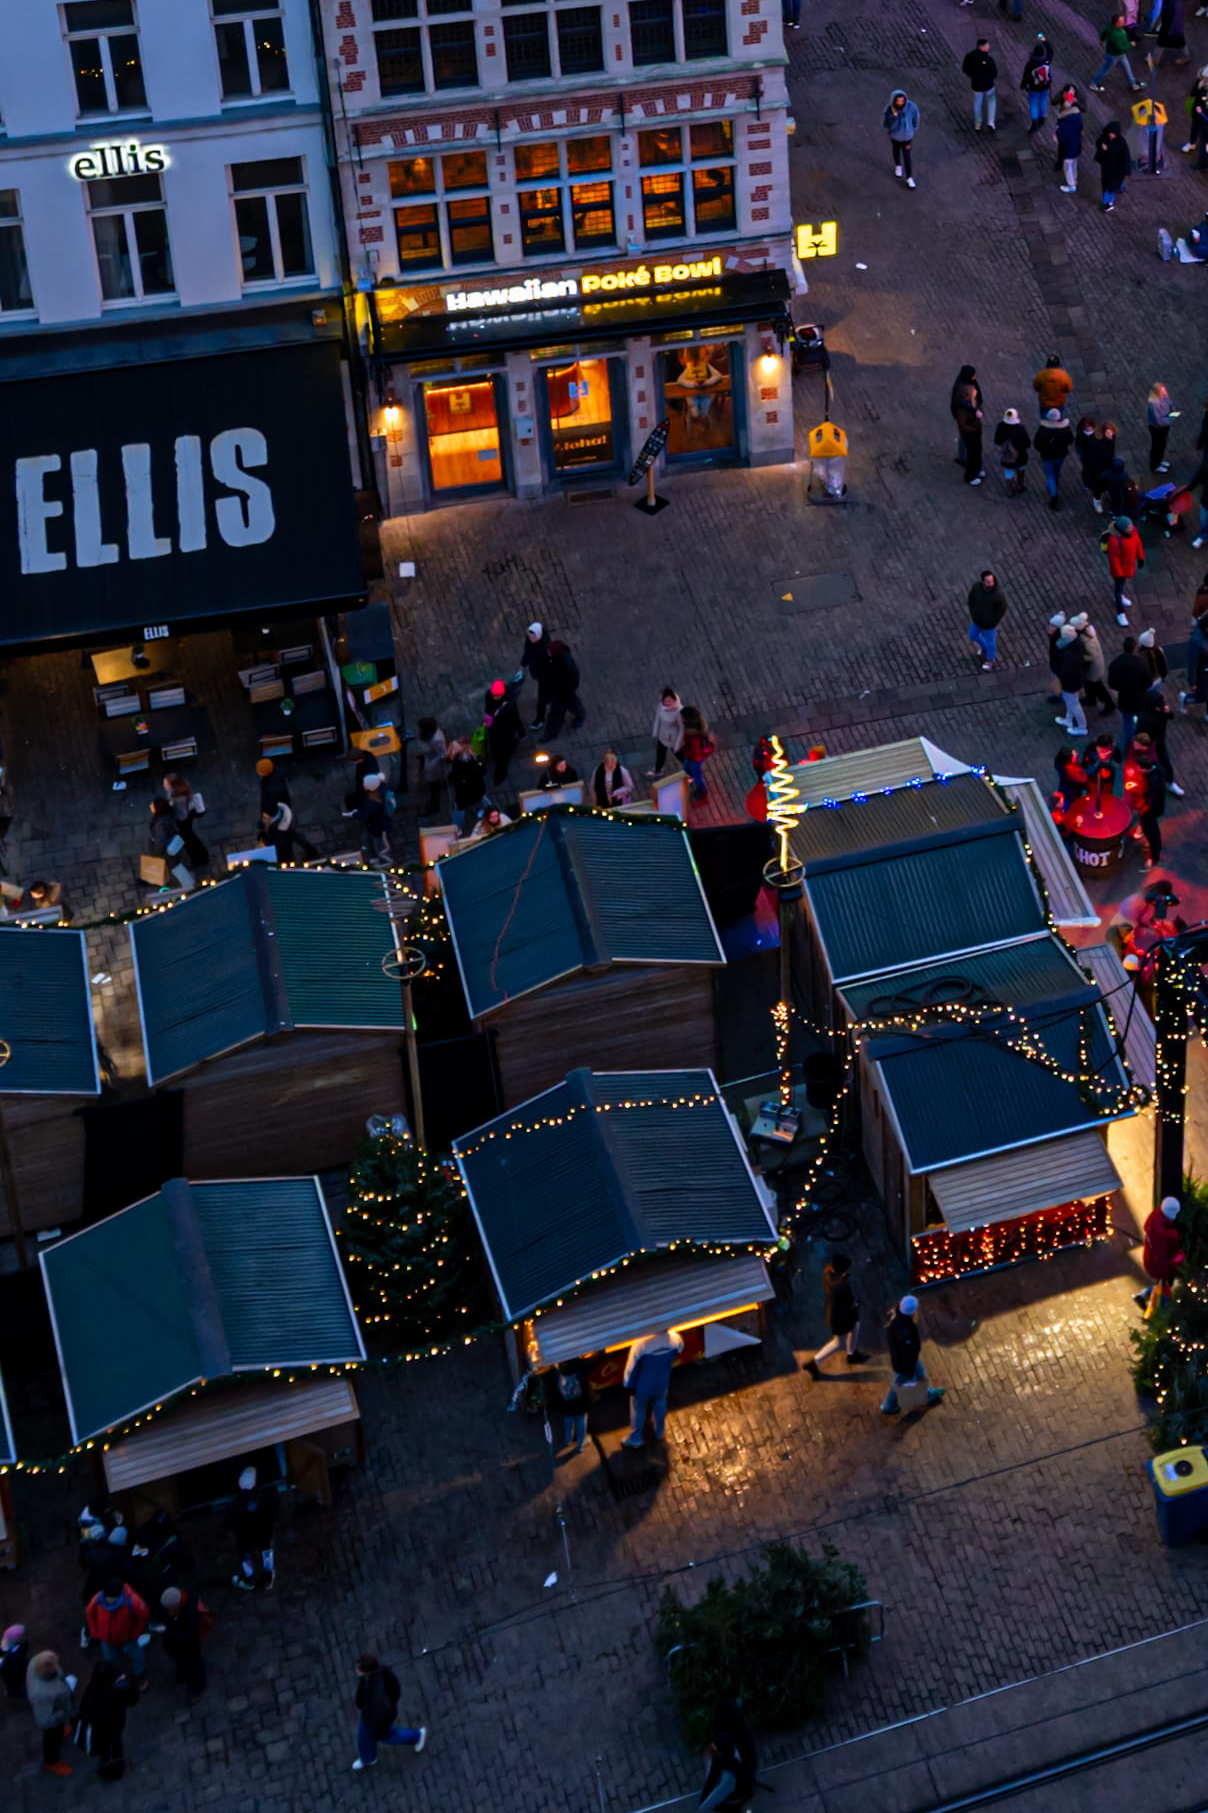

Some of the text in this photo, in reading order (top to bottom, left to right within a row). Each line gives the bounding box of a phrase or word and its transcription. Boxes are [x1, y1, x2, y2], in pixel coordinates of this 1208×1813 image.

[75, 144, 165, 180] ellis
[446, 256, 722, 311] Hawaiian Poké Bowl
[15, 426, 276, 575] ELLIS
[143, 625, 169, 640] ELLIS
